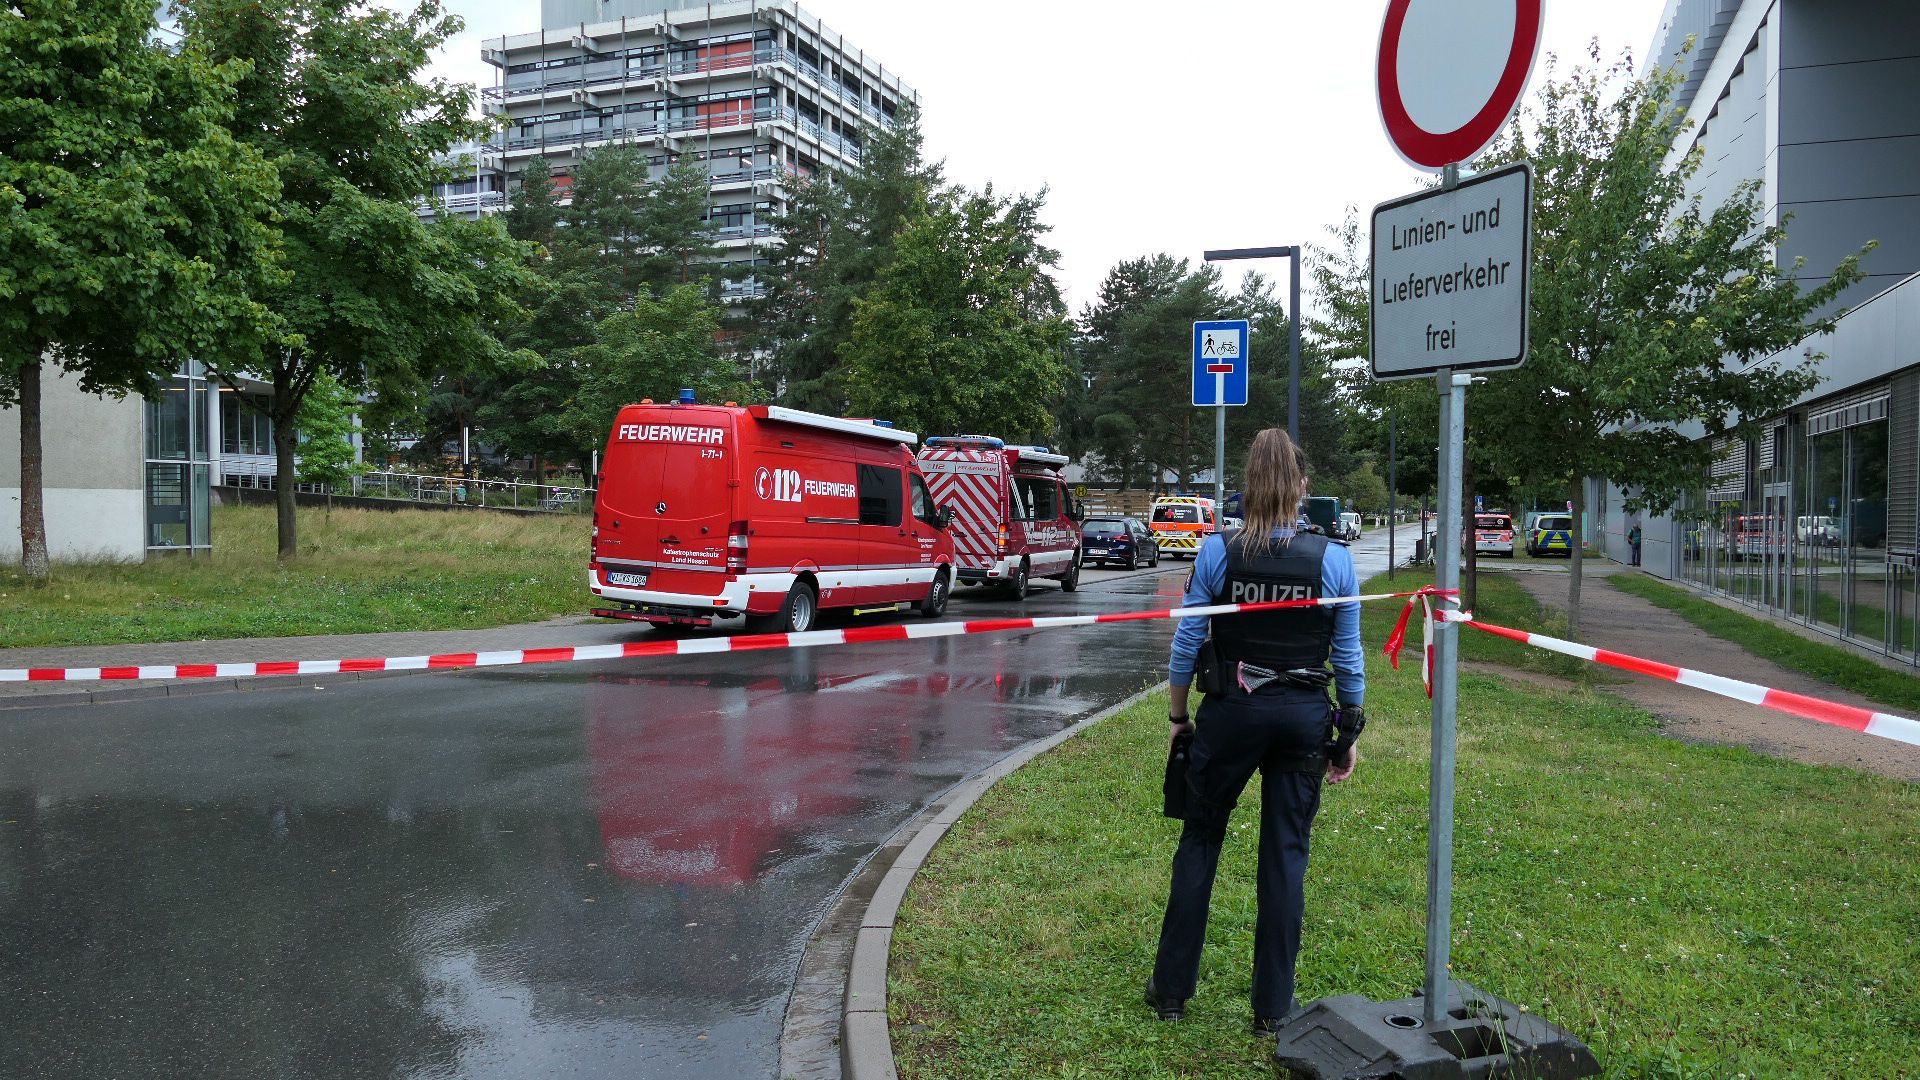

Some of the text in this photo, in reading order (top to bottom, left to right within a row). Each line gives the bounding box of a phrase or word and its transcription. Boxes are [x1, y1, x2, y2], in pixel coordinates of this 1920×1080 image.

[1392, 198, 1500, 251] Linien- und
[1382, 257, 1511, 304] Lieferverkehr
[1425, 320, 1456, 351] frei
[618, 424, 724, 445] FEUERWEHR
[773, 468, 856, 502] 112 FEUERWEHR
[1041, 526, 1058, 547] 112
[663, 548, 720, 559] Katastrophenschutz
[687, 557, 709, 565] Hessen
[1231, 581, 1312, 609] POLIZEI
